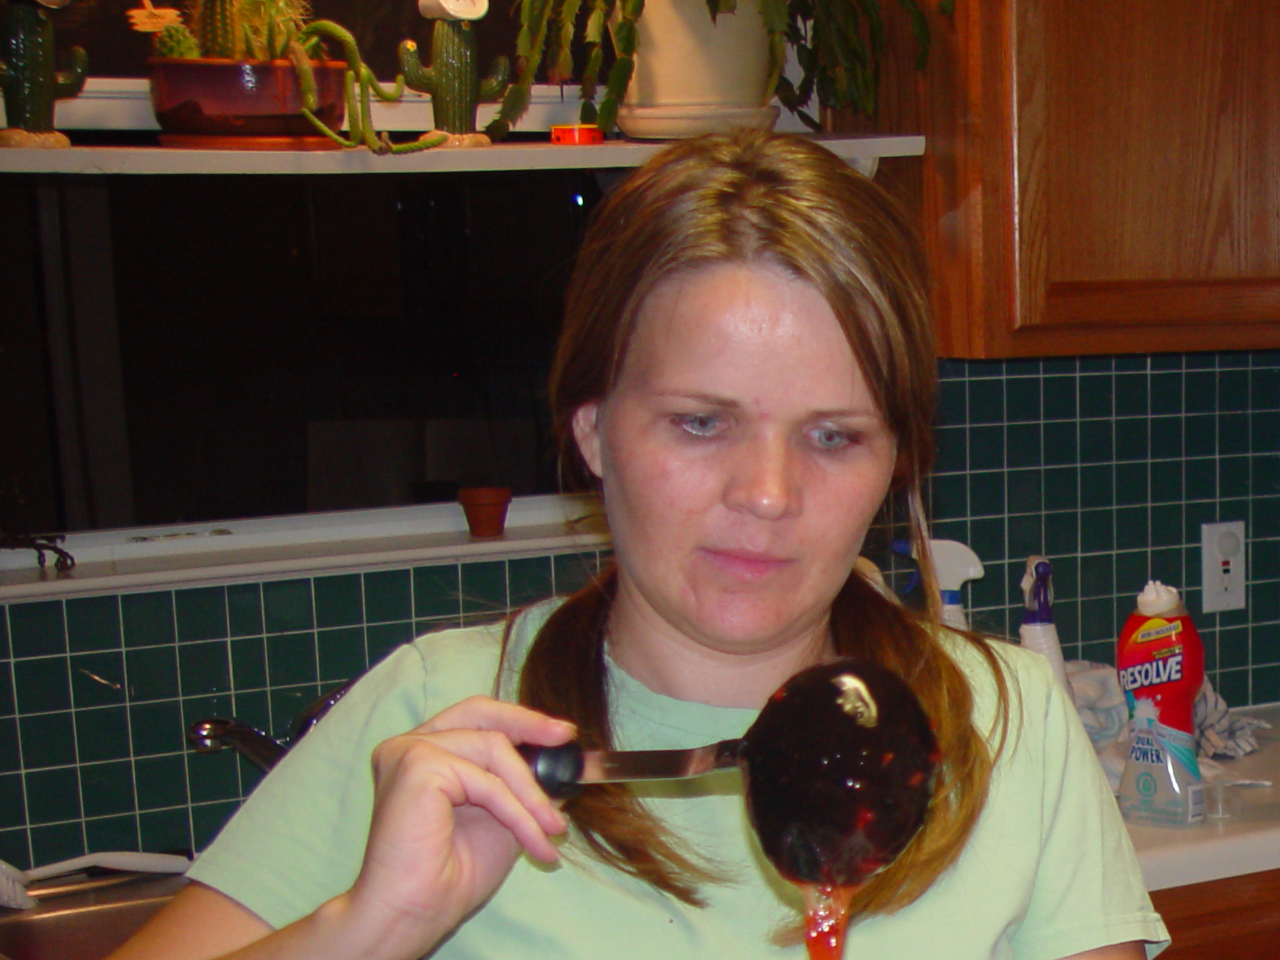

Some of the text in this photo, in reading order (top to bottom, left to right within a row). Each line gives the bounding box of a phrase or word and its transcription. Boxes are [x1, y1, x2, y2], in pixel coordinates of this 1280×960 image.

[1119, 656, 1183, 690] RESOLVE
[1136, 735, 1155, 747] DUAL
[1129, 746, 1164, 764] POWER
